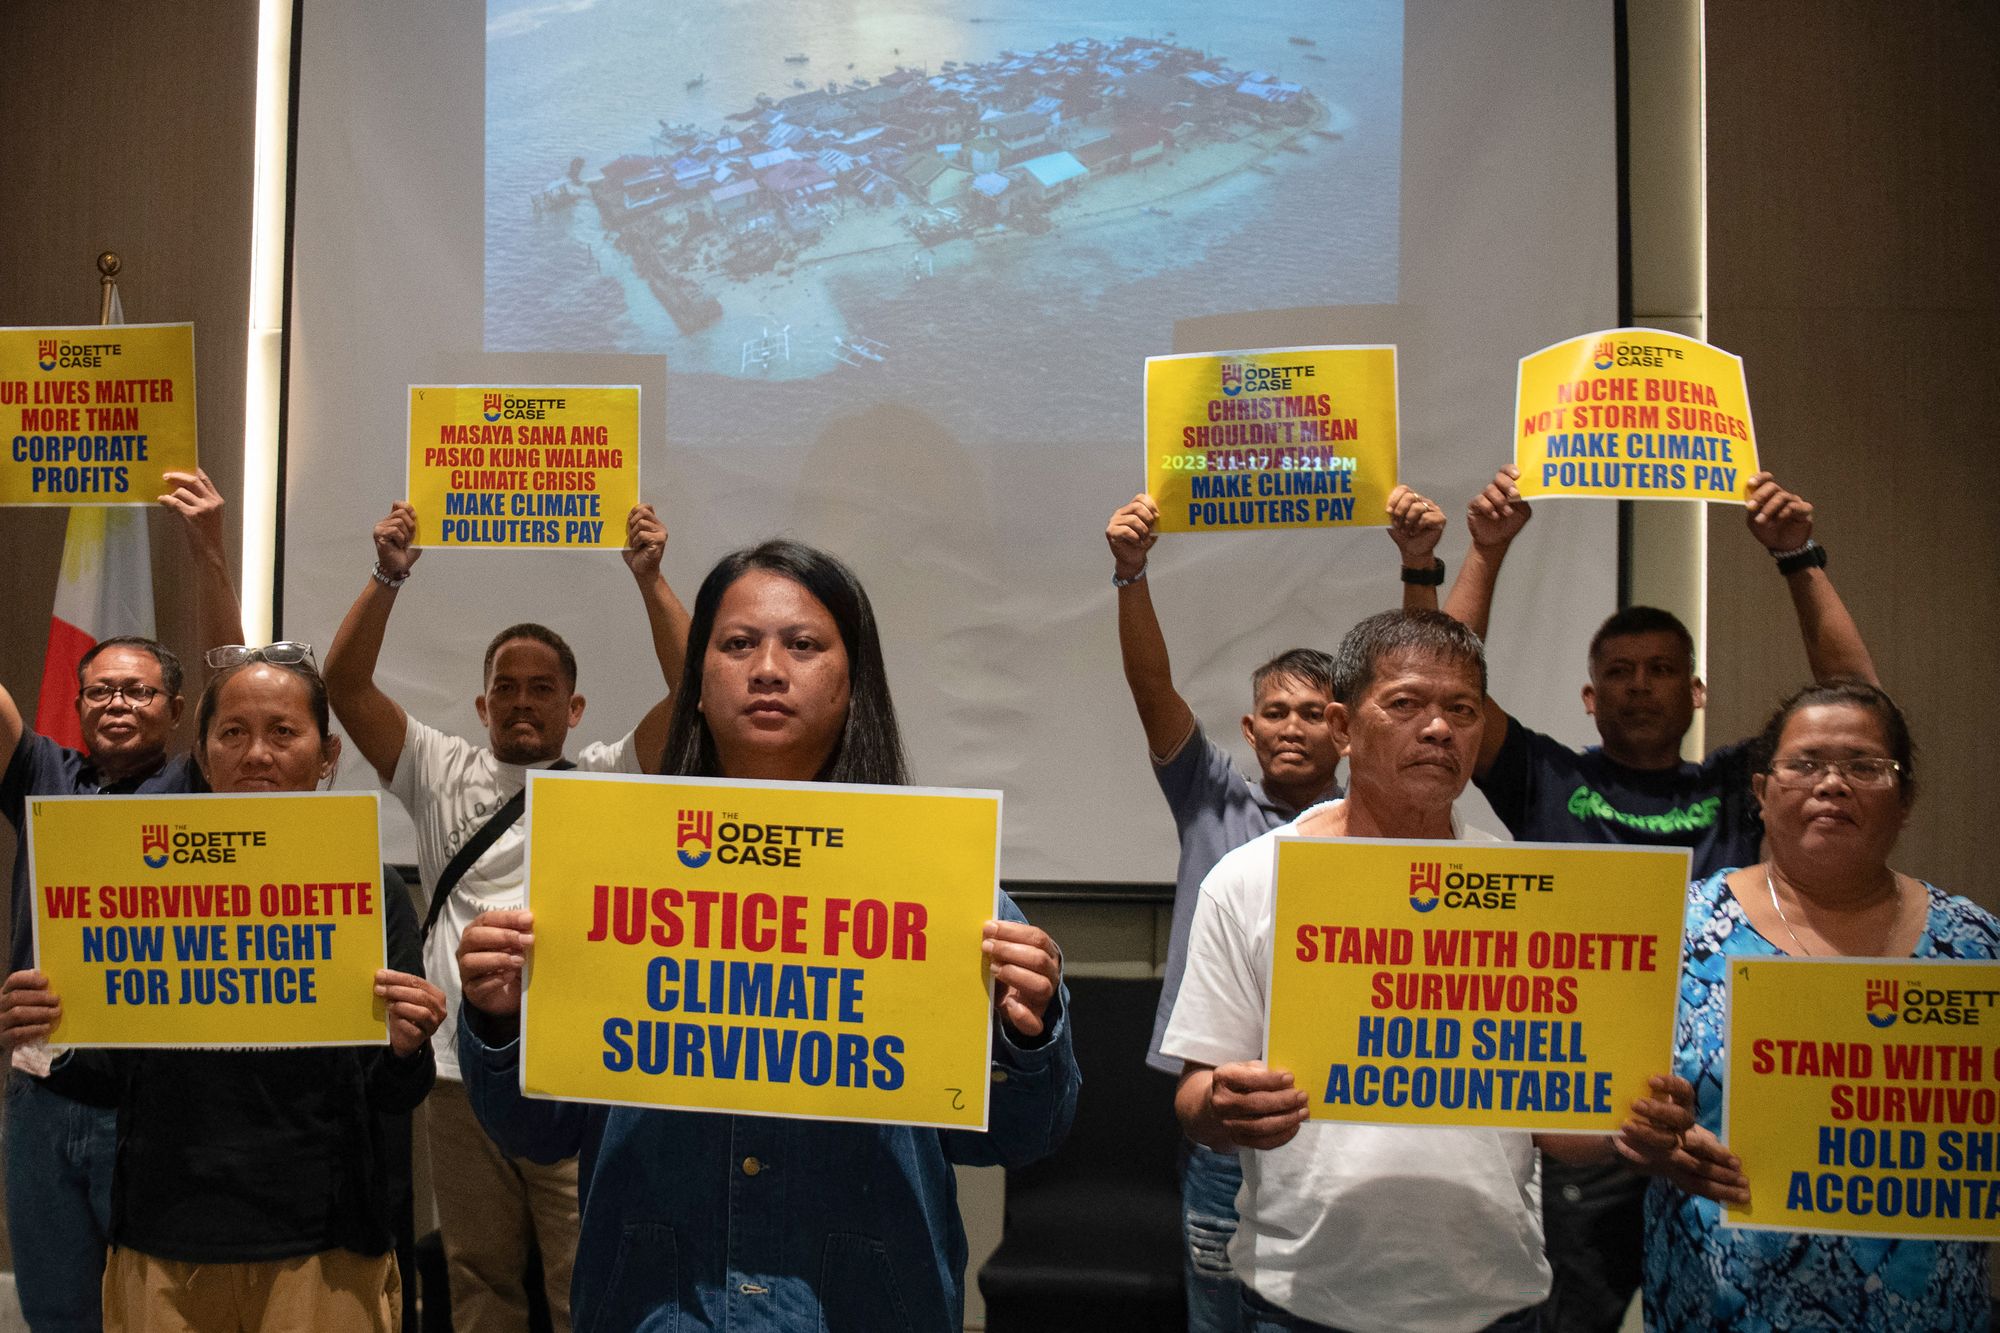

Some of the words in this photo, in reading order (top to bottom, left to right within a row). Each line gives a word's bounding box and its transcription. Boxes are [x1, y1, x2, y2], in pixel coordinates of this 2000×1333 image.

[59, 344, 122, 356] ODETTE
[59, 356, 102, 368] CASE
[1617, 345, 1684, 360] ODETTE
[1617, 356, 1664, 368] CASE
[1245, 366, 1315, 381] ODETTE
[1245, 379, 1292, 392] CASE
[34, 380, 90, 405] LIVES
[96, 379, 173, 403] MATTER
[504, 399, 566, 409] ODETTE
[1558, 378, 1640, 404] NOCHE
[1645, 378, 1719, 408] BUENA
[21, 408, 80, 432] MORE
[85, 407, 138, 432] THAN
[503, 410, 546, 420] CASE
[1208, 394, 1331, 422] CHRISTMAS
[440, 425, 513, 445] MASAYA
[518, 426, 567, 445] SANA
[570, 426, 608, 446] ANG
[1183, 422, 1294, 448] SHOULDN'T
[1300, 418, 1358, 442] MEAN
[1523, 408, 1567, 438] NOT
[1573, 405, 1659, 429] STORM
[1666, 406, 1748, 441] SURGES
[12, 435, 148, 462] CORPORATE
[425, 448, 484, 467] PASKO
[489, 448, 540, 468] KUNG
[545, 449, 623, 469] WALANG
[1547, 433, 1619, 458] MAKE
[1627, 433, 1733, 463] CLIMATE
[1161, 455, 1269, 471] 2023-11-17
[1329, 456, 1357, 471] PM
[32, 466, 129, 493] PROFITS
[451, 470, 528, 490] CLIMATE
[532, 471, 596, 491] CRISIS
[1191, 474, 1252, 499] MAKE
[1258, 470, 1352, 495] CLIMATE
[1542, 462, 1686, 489] POLLUTERS
[1694, 466, 1737, 492] PAY
[446, 493, 505, 516] MAKE
[511, 494, 600, 517] CLIMATE
[1189, 498, 1310, 525] POLLUTERS
[1316, 497, 1356, 521] PAY
[442, 519, 560, 543] POLLUTERS
[566, 520, 604, 544] PAY
[721, 811, 739, 820] THE
[172, 831, 266, 847] ODETTE
[718, 822, 844, 849] ODETTE
[172, 849, 236, 864] CASE
[716, 845, 801, 868] CASE
[1445, 872, 1554, 892] ODETTE
[44, 885, 92, 919] WE
[99, 884, 251, 919] SURVIVED
[259, 882, 373, 917] ODETTE
[1444, 890, 1517, 910] CASE
[587, 884, 808, 955] JUSTICE
[823, 897, 928, 961] FOR
[82, 925, 164, 963] NOW
[173, 924, 226, 962] WE
[236, 923, 336, 961] FIGHT
[1296, 924, 1414, 966] STAND
[1423, 929, 1518, 968] WITH
[1528, 931, 1658, 972] ODETTE
[105, 968, 169, 1005] FOR
[179, 967, 317, 1005] JUSTICE
[646, 956, 865, 1024] CLIMATE
[1371, 971, 1578, 1014] SURVIVORS
[1903, 1007, 1979, 1025] CASE
[1357, 1015, 1461, 1059] HOLD
[1472, 1018, 1587, 1063] SHELL
[602, 1017, 905, 1092] SURVIVORS
[1752, 1038, 1873, 1079] STAND
[1883, 1044, 1983, 1082] WITH
[1324, 1063, 1612, 1113] ACCOUNTABLE
[1831, 1084, 2000, 1125] SURVIVO
[1818, 1126, 1926, 1169] HOLD
[1938, 1130, 2000, 1172] SH
